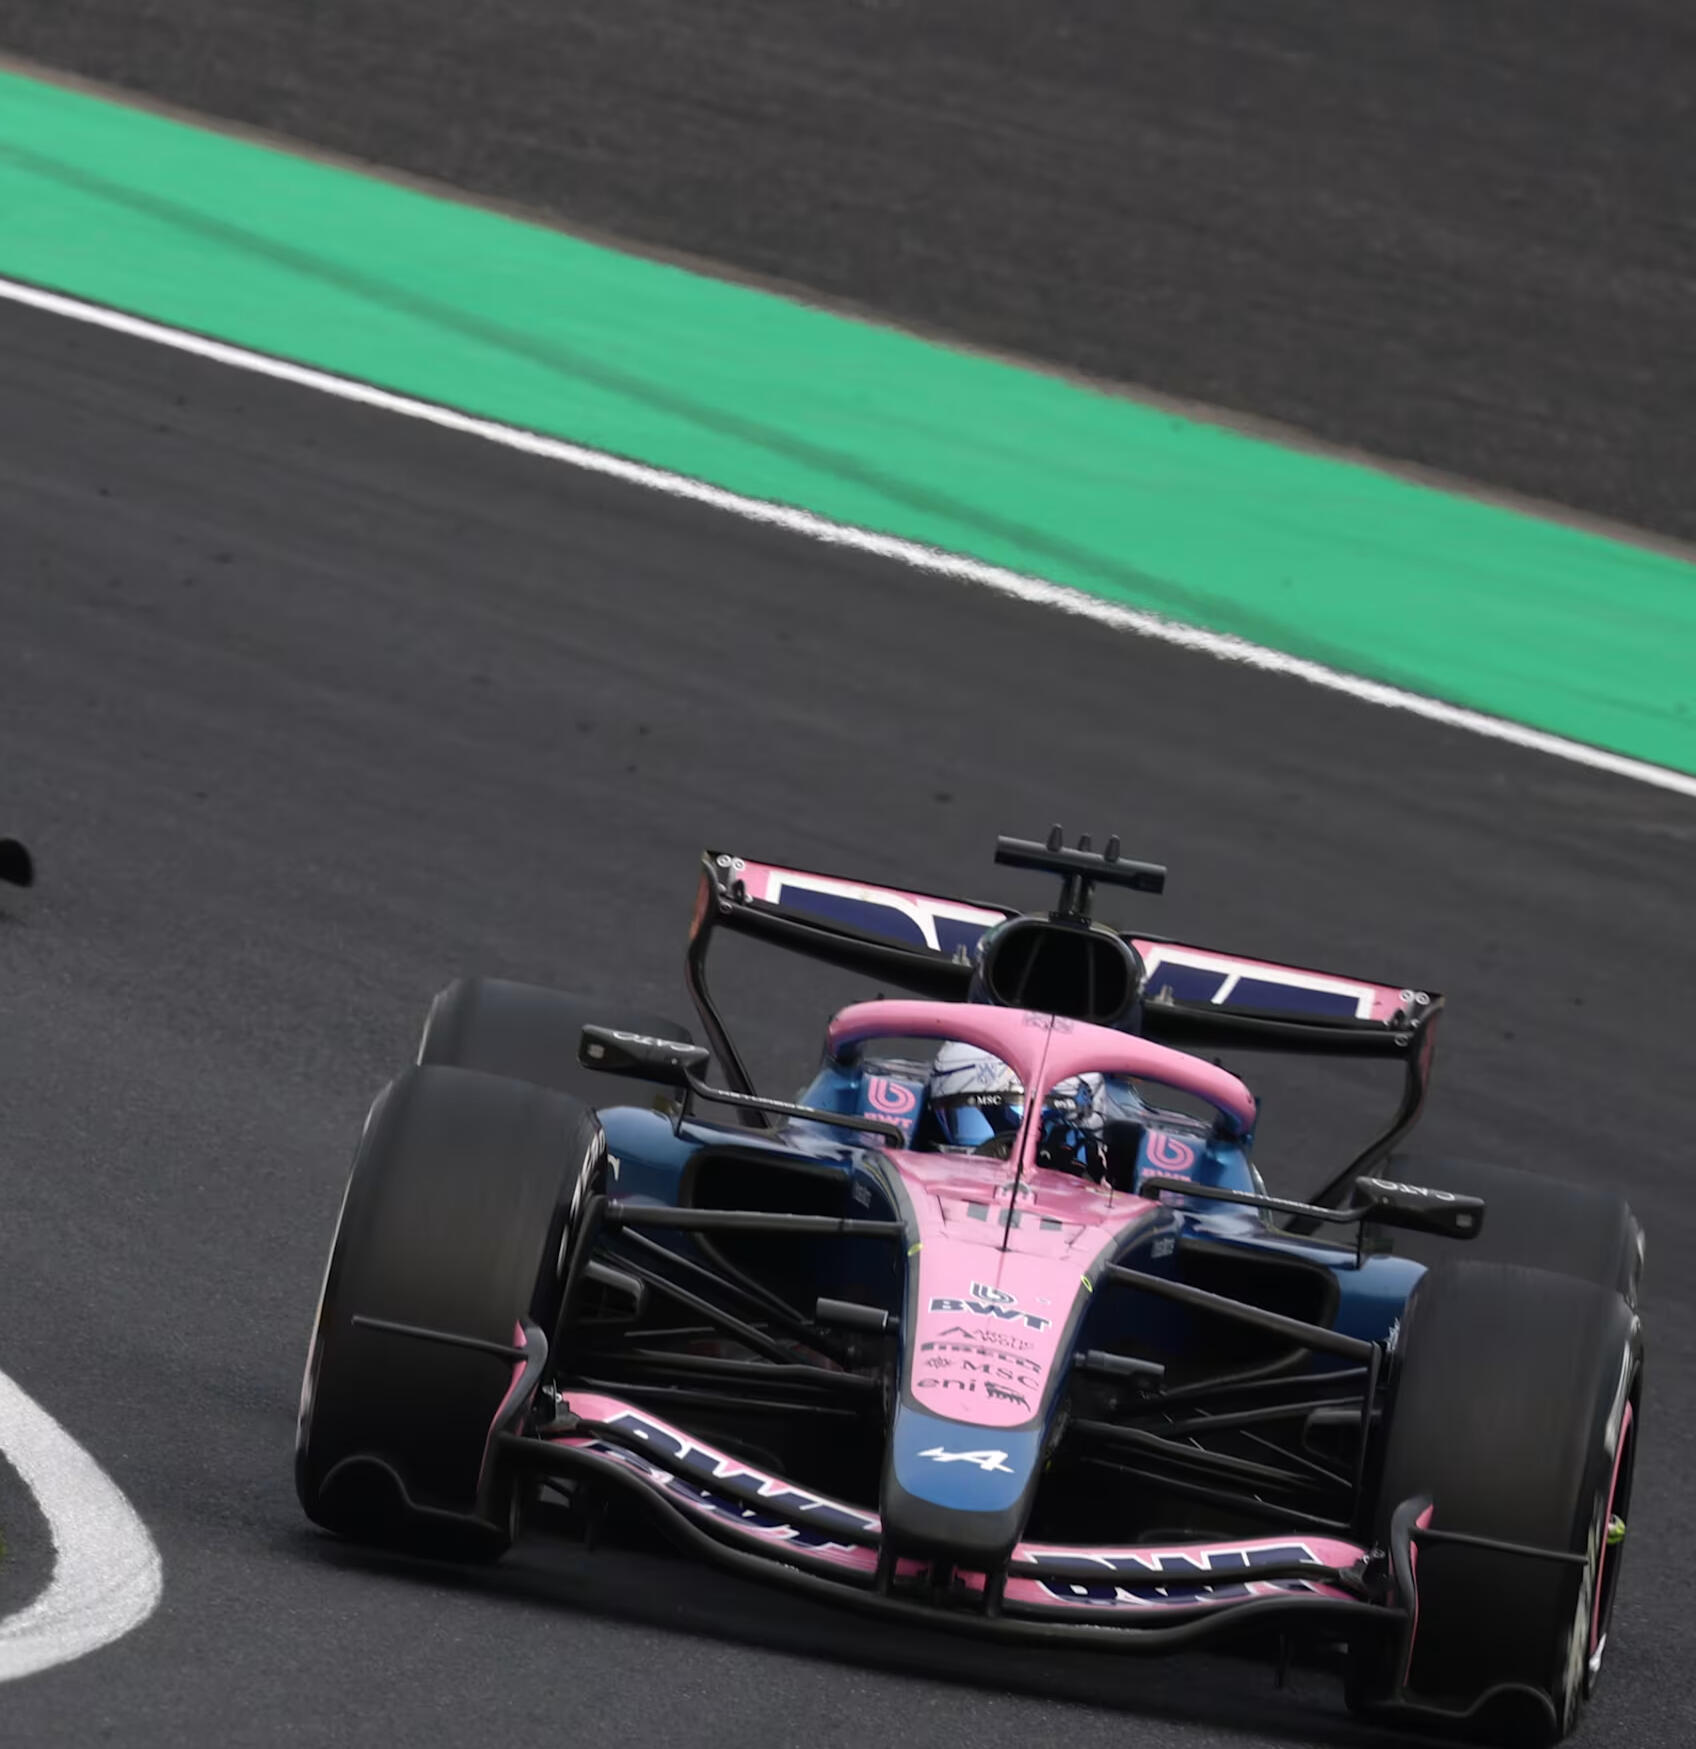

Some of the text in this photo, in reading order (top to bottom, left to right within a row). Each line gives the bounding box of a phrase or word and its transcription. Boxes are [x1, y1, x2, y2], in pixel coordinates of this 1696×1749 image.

[976, 1095, 1002, 1106] MSC
[929, 1297, 1052, 1332] BWT
[917, 1378, 976, 1393] eni
[962, 1359, 1040, 1392] MSC
